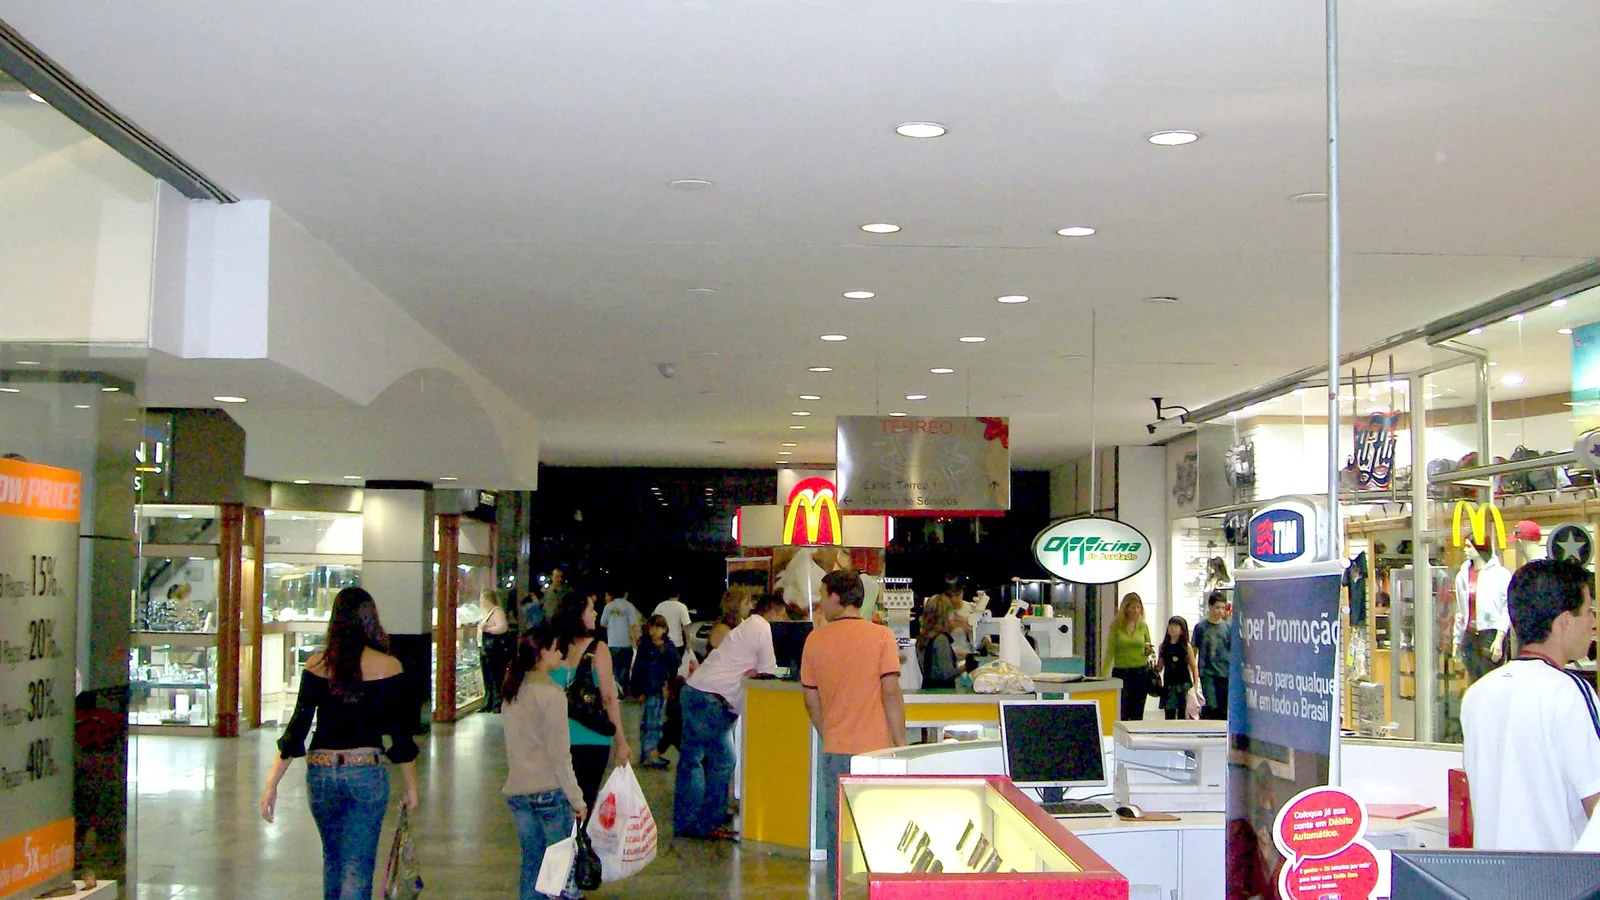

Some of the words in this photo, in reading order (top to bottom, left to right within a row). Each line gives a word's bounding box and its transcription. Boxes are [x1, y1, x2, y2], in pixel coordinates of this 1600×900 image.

[25, 477, 79, 510] PRICE
[1273, 519, 1298, 555] TIM
[1099, 552, 1138, 560] bordado
[31, 555, 57, 597] 15%
[29, 618, 57, 661] 20%
[1267, 611, 1339, 654] Promoção
[1255, 665, 1273, 686] Zero
[1275, 672, 1294, 691] para
[1296, 671, 1335, 699] qualque
[28, 679, 55, 721] 30%
[1259, 697, 1271, 711] em
[1271, 694, 1291, 716] todo
[1292, 700, 1299, 717] o
[1300, 697, 1329, 722] Brasil
[1293, 808, 1323, 820] Coloque
[1324, 807, 1332, 818] já
[1332, 807, 1346, 815] sua
[1293, 821, 1314, 831] conta
[1315, 820, 1327, 828] em
[1328, 816, 1354, 827] Débito
[1293, 829, 1340, 842] Automático.
